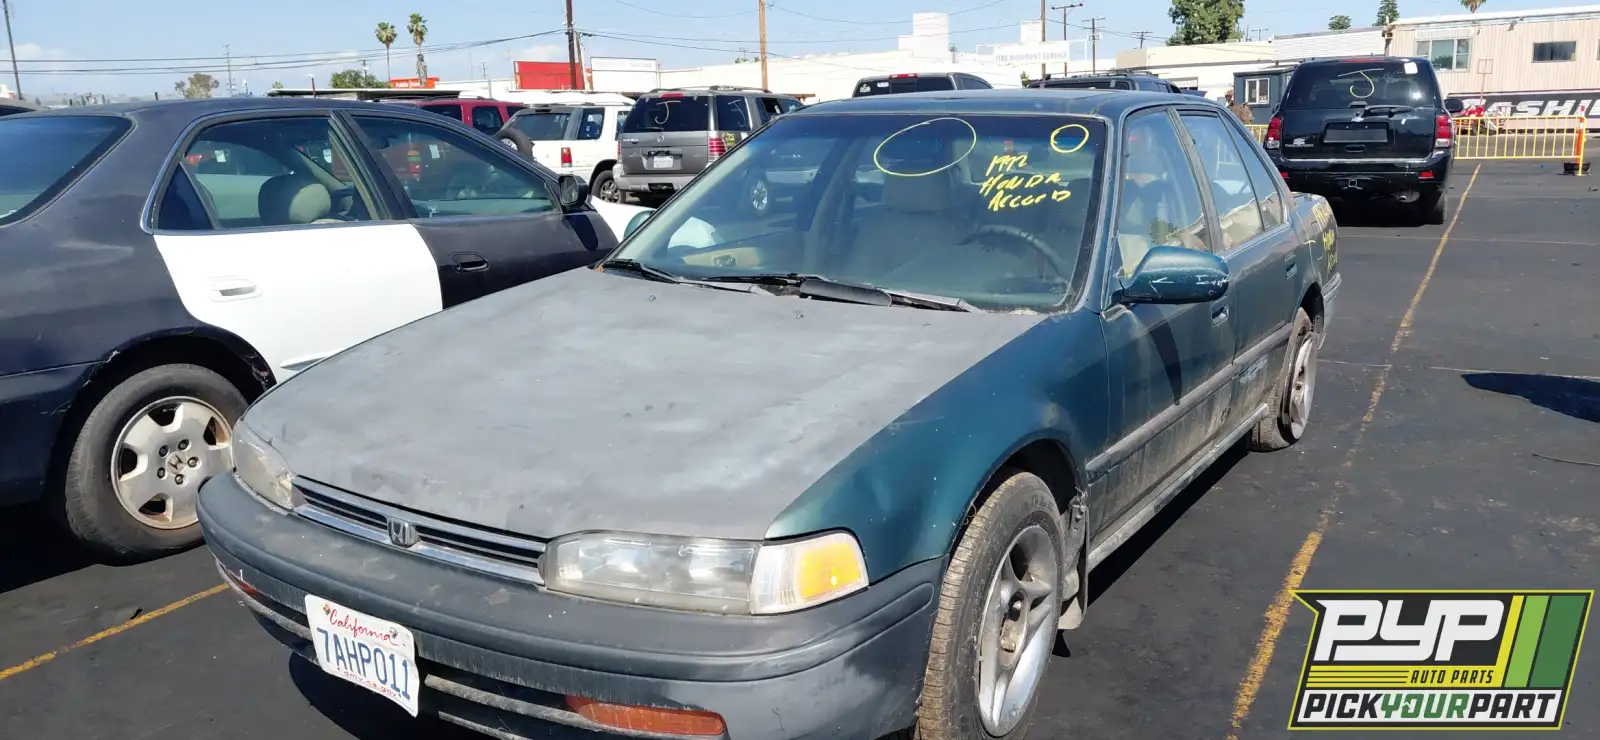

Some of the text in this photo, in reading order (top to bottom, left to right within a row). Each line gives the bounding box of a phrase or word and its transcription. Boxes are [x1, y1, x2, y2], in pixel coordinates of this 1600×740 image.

[1042, 51, 1067, 60] SERVICE
[1337, 68, 1384, 98] J
[655, 100, 682, 125] J
[328, 608, 400, 647] California
[316, 627, 410, 701] 7AHP011
